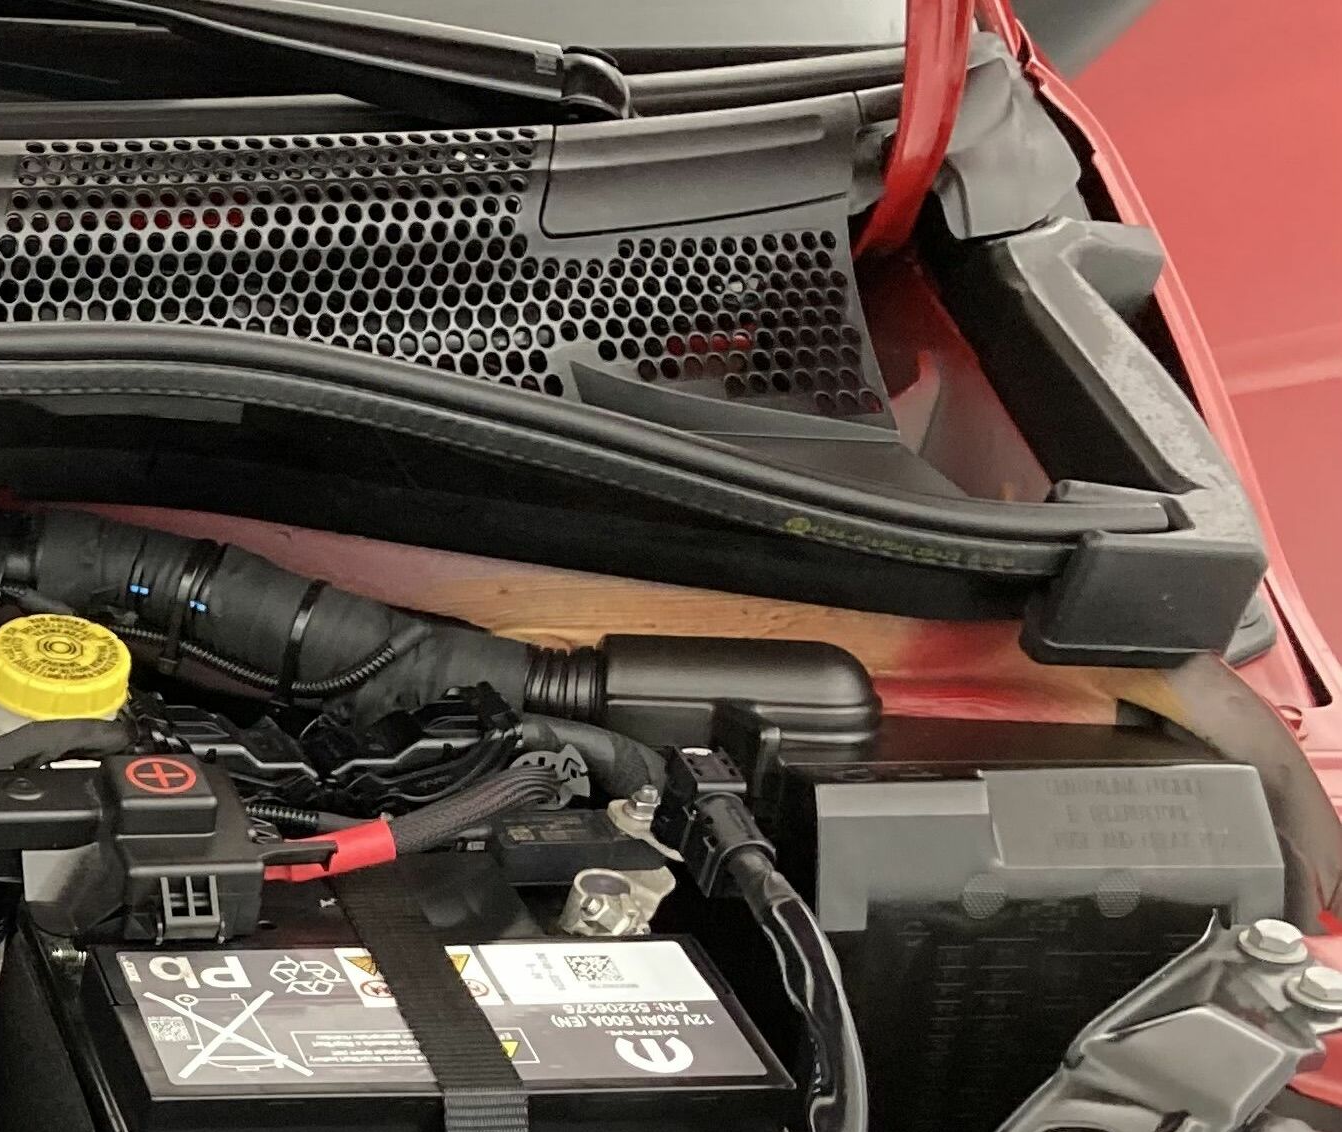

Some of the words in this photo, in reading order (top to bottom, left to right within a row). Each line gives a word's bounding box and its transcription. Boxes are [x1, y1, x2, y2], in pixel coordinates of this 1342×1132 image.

[149, 955, 252, 989] Pb
[655, 1001, 689, 1013] PN:
[550, 1014, 587, 1028] (EN)
[589, 1014, 634, 1027] 500A
[635, 1014, 680, 1027] 50Ah
[683, 1013, 715, 1026] 12V
